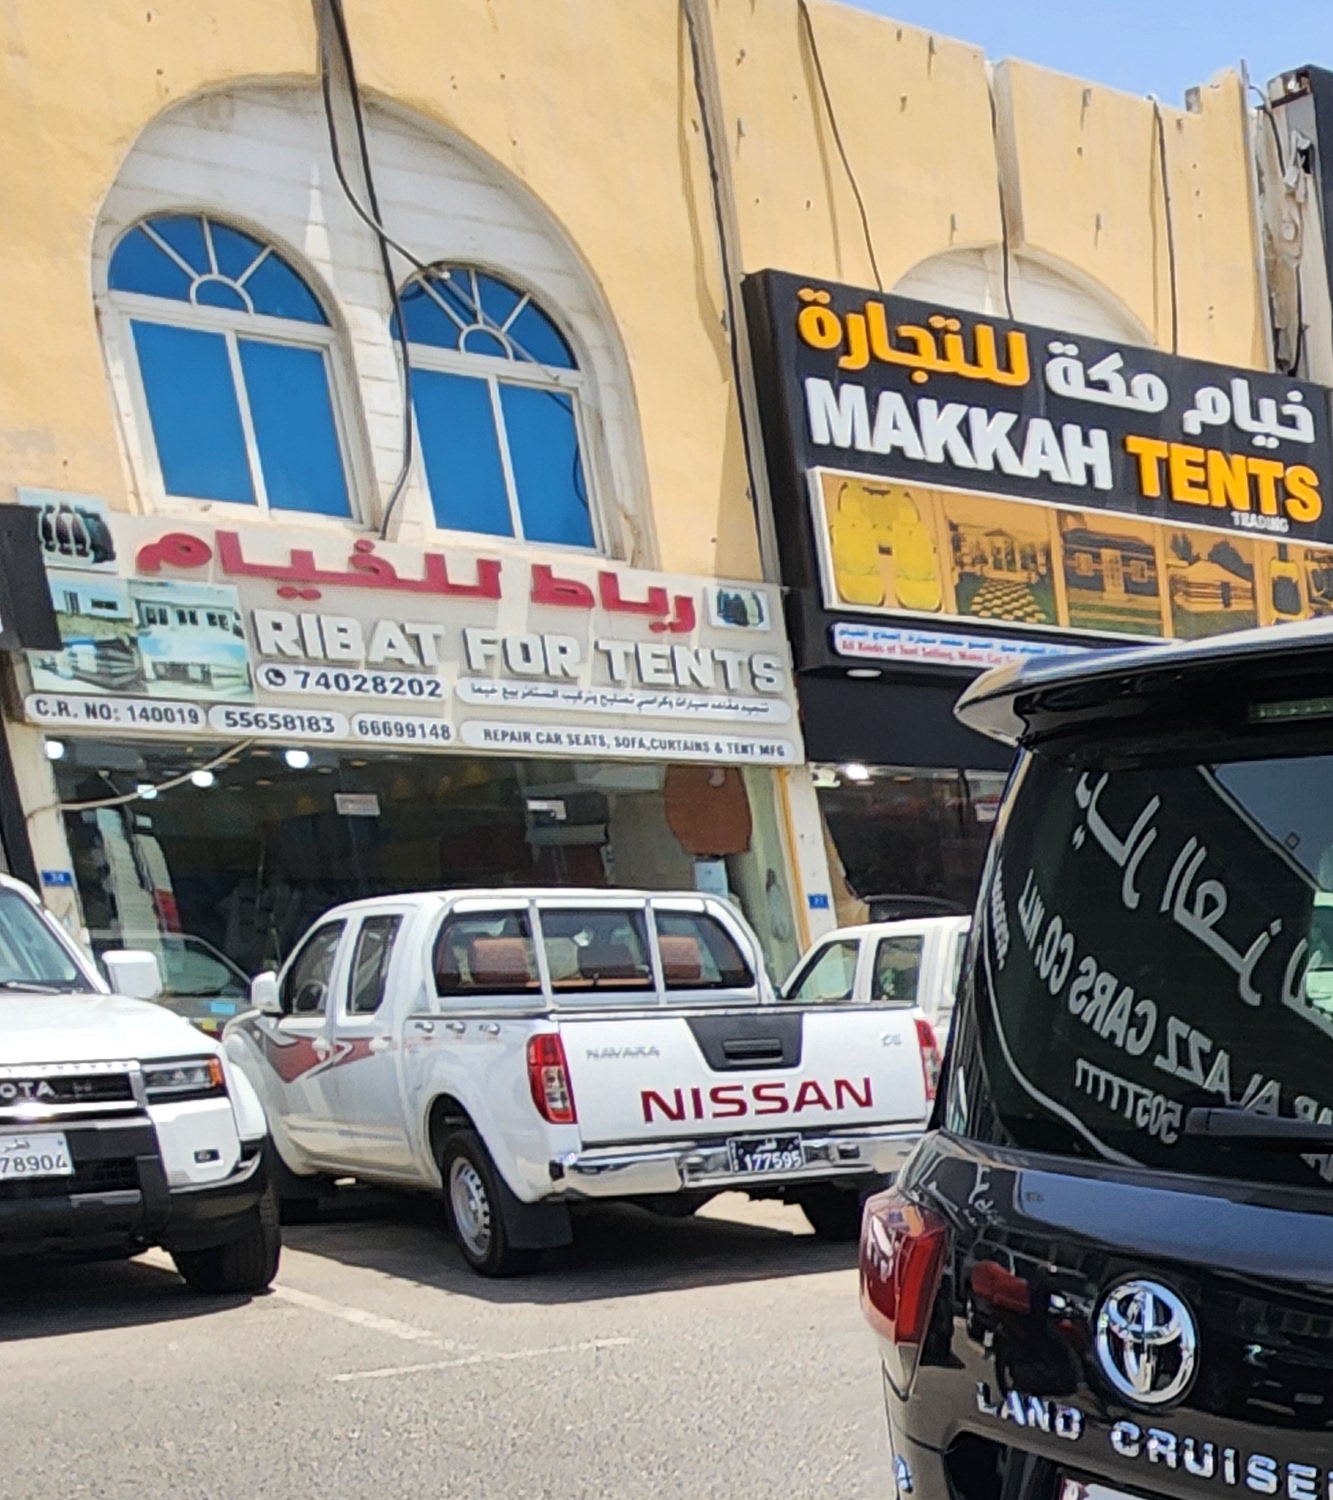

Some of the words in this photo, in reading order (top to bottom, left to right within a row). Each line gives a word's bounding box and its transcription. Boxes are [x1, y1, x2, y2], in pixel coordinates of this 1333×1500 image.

[797, 287, 1031, 386] للتجارة
[1045, 340, 1169, 414] مكة
[1182, 377, 1316, 449] خيام
[803, 376, 1114, 490] MAKKAH
[1125, 433, 1324, 524] TENTS
[1230, 510, 1290, 533] TRADING
[136, 530, 503, 601] للخيام
[531, 562, 697, 633] رباط
[251, 609, 445, 667] RIBAT
[461, 627, 582, 679] FOR
[594, 639, 788, 693] TENTS
[292, 669, 444, 699] 74028202
[35, 700, 79, 718] C.R.
[84, 703, 120, 723] NO:
[126, 705, 200, 726] 140019
[224, 711, 336, 734] 55658183
[357, 718, 452, 742] 66699148
[483, 729, 532, 744] REPAIR
[535, 732, 564, 746] CAR
[566, 734, 611, 749] SEATS,
[714, 741, 723, 754] &
[726, 742, 756, 755] TENT
[759, 744, 786, 757] MFG
[640, 1077, 873, 1124] NISSAN
[744, 1150, 802, 1171] 177595
[976, 1382, 1085, 1441] LAND
